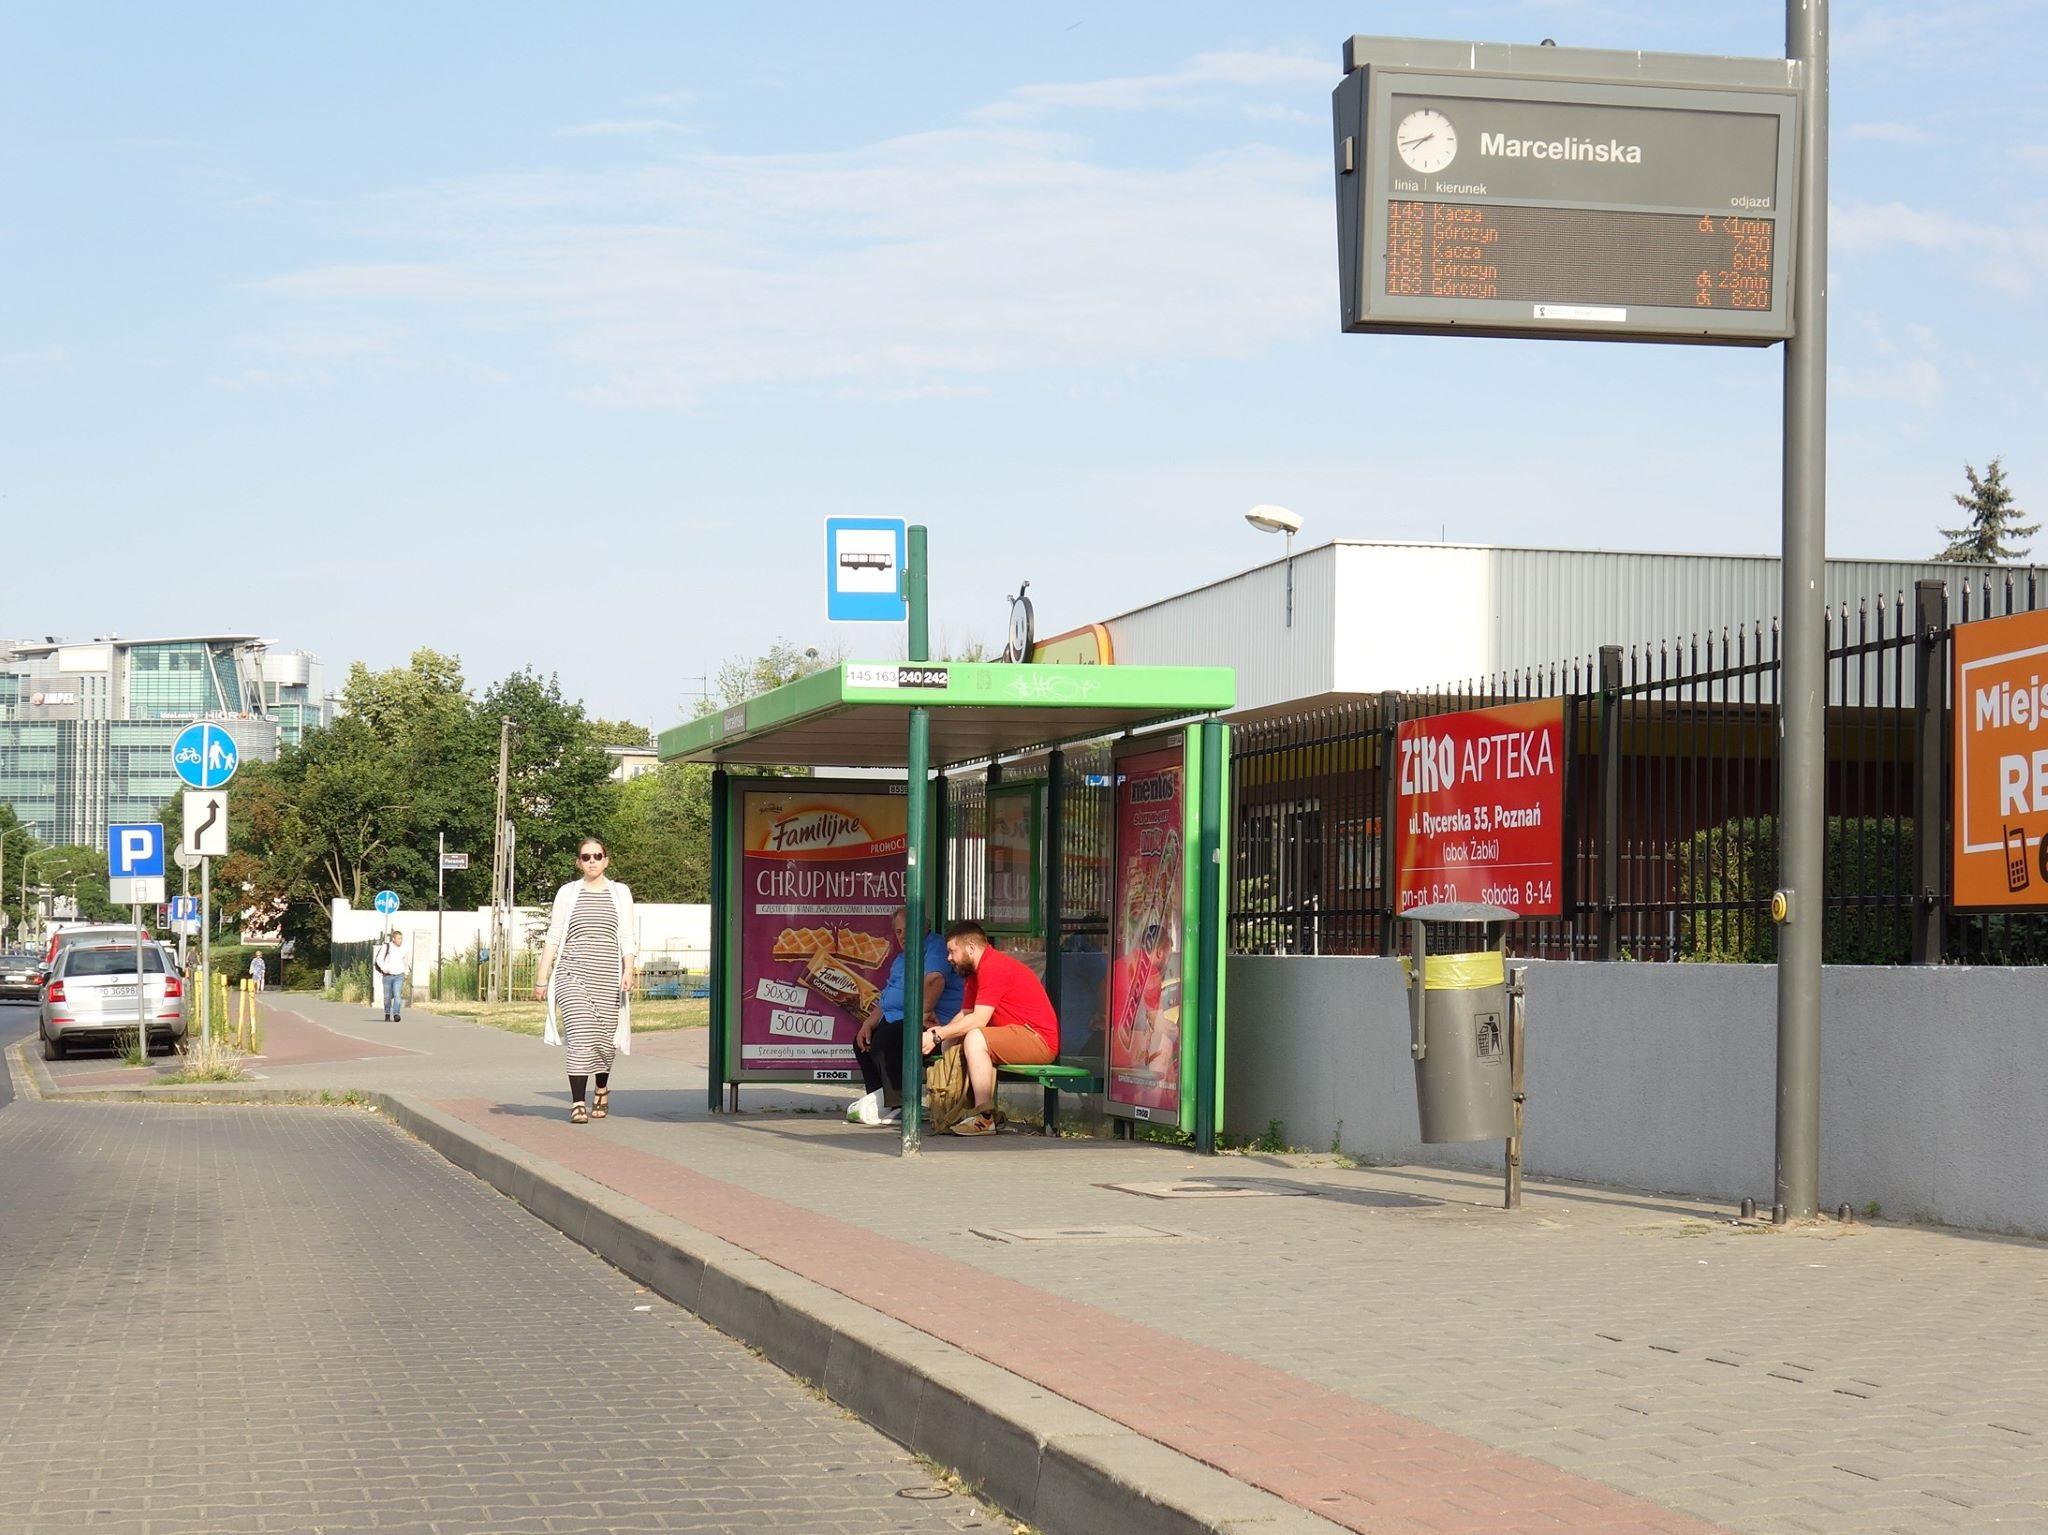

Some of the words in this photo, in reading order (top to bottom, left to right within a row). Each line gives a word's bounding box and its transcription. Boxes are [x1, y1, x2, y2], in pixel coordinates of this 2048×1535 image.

[1480, 132, 1641, 163] Marcelińska
[1394, 179, 1419, 191] linia
[1436, 181, 1487, 195] kierunek
[1390, 201, 1424, 219] 145
[1434, 203, 1484, 222] Kacza
[1731, 196, 1770, 209] odjazd
[1390, 220, 1424, 238] 163
[1433, 221, 1498, 244] Górczyn
[1734, 235, 1770, 252] 7:50
[1390, 239, 1423, 256] 145
[1433, 240, 1484, 259] Kacza
[1733, 253, 1769, 271] 8:04
[1389, 257, 1423, 275] 163
[1432, 259, 1498, 281] Górczyn
[1719, 271, 1768, 289] 23min
[1389, 276, 1422, 294] 163
[1432, 278, 1497, 299] Górczyn
[1733, 289, 1768, 307] 8:20
[851, 671, 871, 681] 145
[876, 671, 896, 682] 163
[900, 671, 922, 683] 240
[924, 672, 947, 684] 242
[1460, 728, 1554, 784] APTEKA
[1130, 774, 1175, 804] mentos
[2000, 749, 2048, 817] RE
[773, 814, 861, 852] Familijne
[1409, 813, 1421, 835] ul.
[1423, 807, 1472, 839] Rycerska
[1473, 806, 1492, 833] 35,
[1494, 801, 1541, 829] Poznań
[121, 829, 154, 872] P
[1442, 841, 1469, 862] (obok
[1469, 836, 1500, 862] Żabki)
[756, 870, 855, 898] CHRUPNIJ
[1432, 883, 1457, 905] 8-20
[1481, 883, 1520, 905] sobota
[1525, 880, 1553, 905] 8-14
[178, 898, 193, 918] P
[813, 978, 839, 996] Gofrowe
[819, 966, 858, 992] Familijne
[764, 983, 798, 1003] 50x50
[758, 1046, 795, 1058] Szczegóły
[796, 1047, 807, 1055] na:
[816, 1070, 848, 1079] STRÖER
